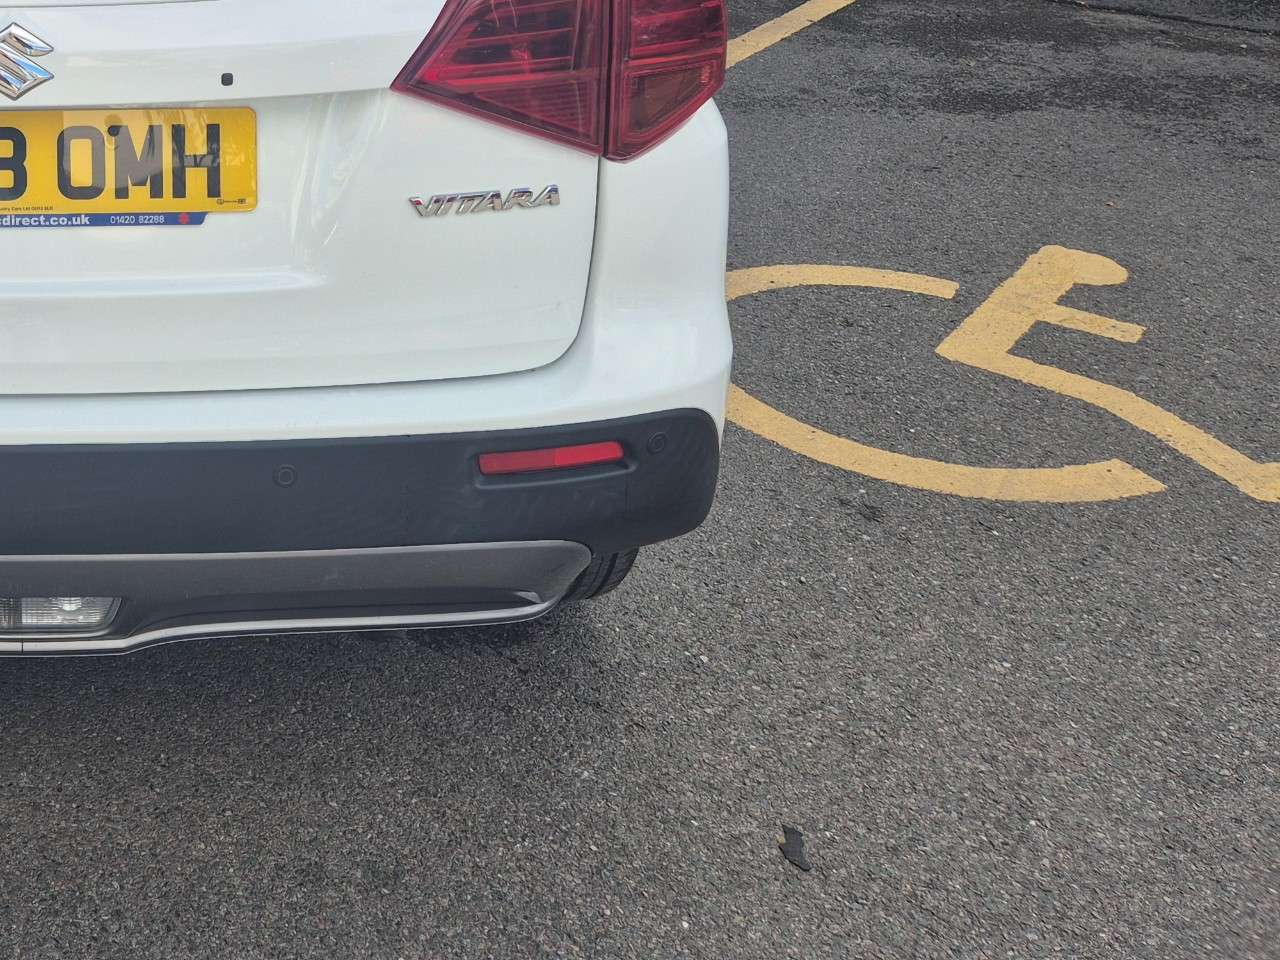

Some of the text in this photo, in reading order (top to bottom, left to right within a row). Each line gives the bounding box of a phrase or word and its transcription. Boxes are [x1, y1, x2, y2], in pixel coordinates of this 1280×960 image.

[56, 123, 221, 200] OMH
[408, 184, 560, 218] VITARA
[110, 215, 135, 225] 01420
[138, 214, 165, 224] 82288
